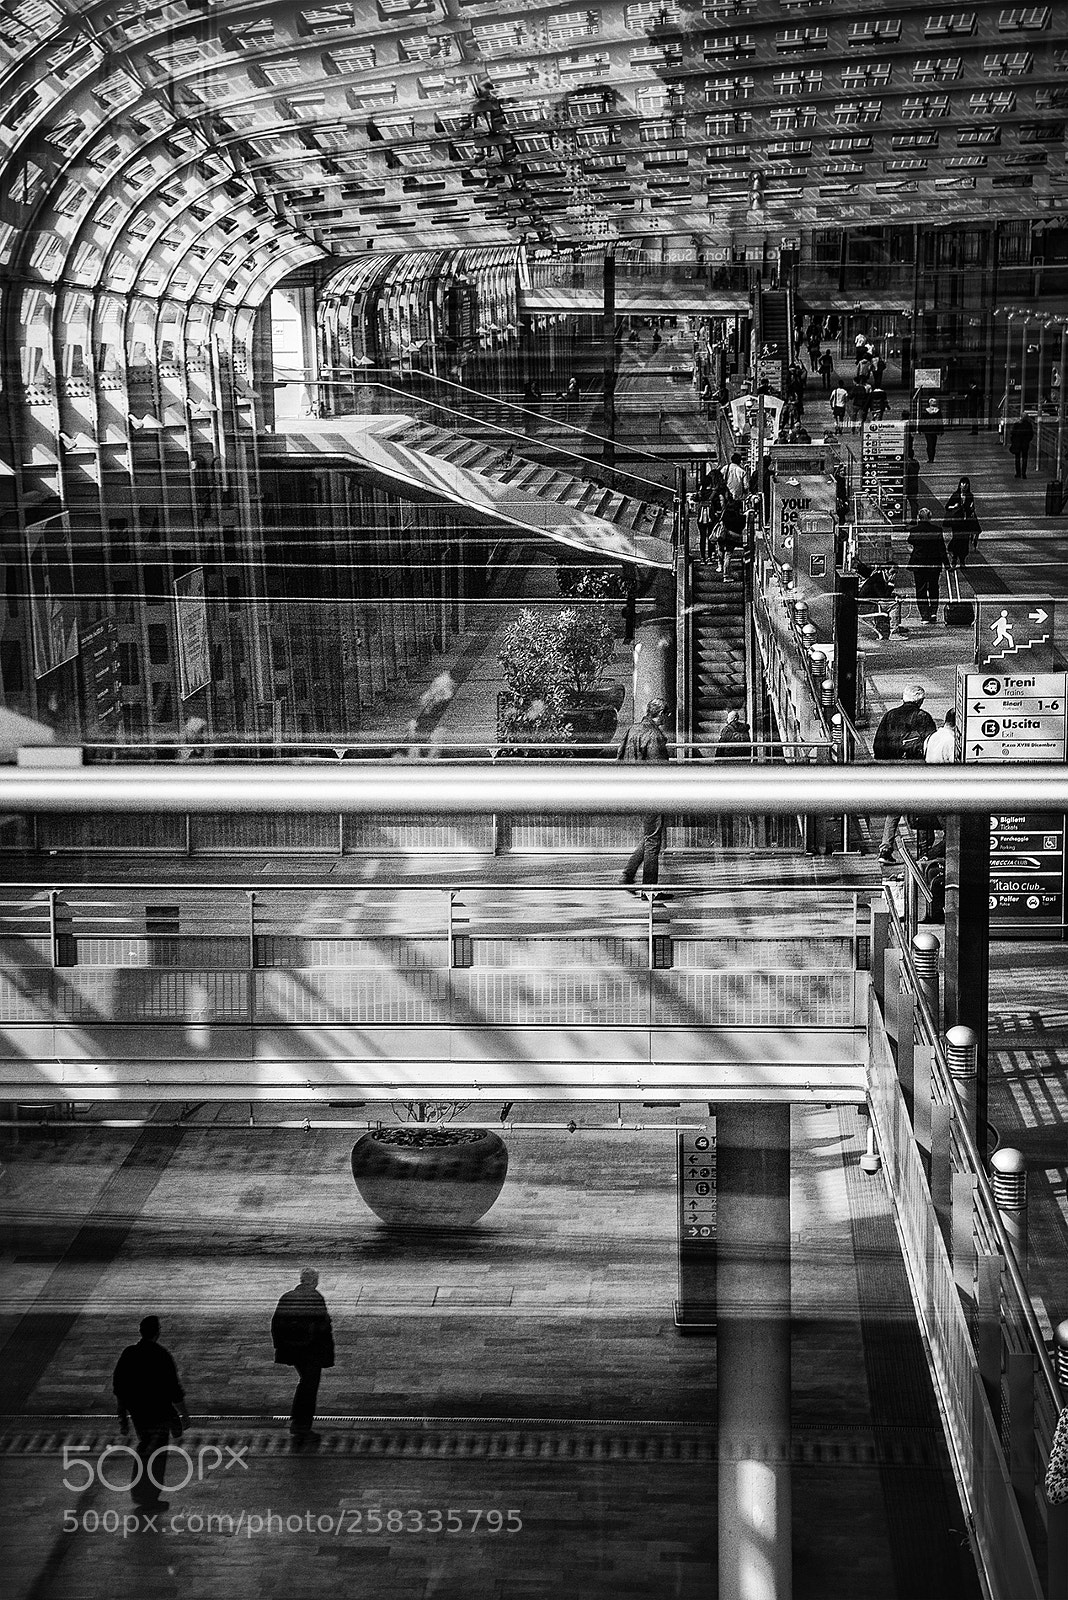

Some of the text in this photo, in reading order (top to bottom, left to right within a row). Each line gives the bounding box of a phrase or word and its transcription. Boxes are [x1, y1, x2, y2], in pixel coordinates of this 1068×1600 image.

[781, 498, 812, 512] your
[781, 523, 795, 535] br
[1003, 677, 1036, 687] Treni
[1037, 700, 1060, 711] 1-6
[1002, 718, 1041, 729] Uscita
[1001, 730, 1014, 738] Exit
[1000, 816, 1026, 824] Biglietti
[1020, 882, 1040, 891] Club
